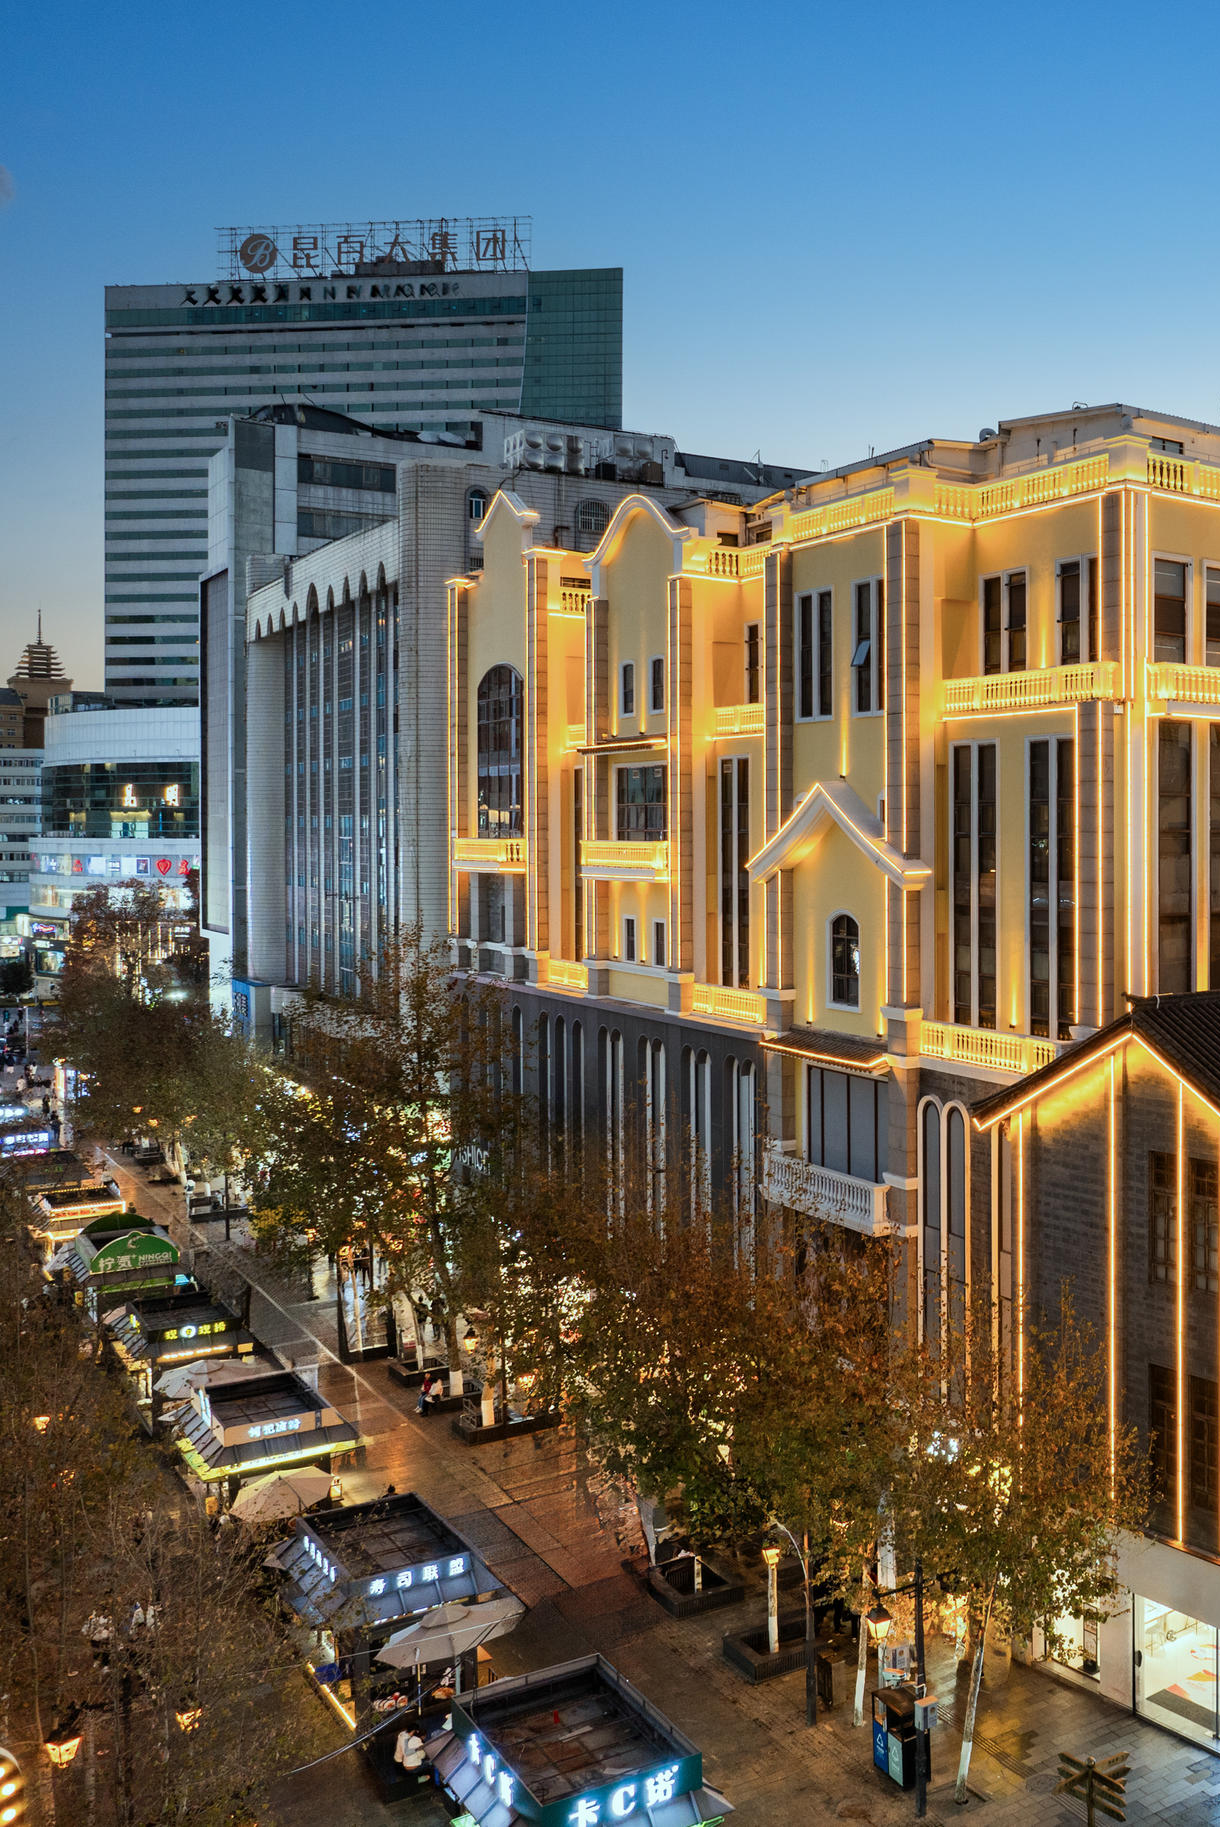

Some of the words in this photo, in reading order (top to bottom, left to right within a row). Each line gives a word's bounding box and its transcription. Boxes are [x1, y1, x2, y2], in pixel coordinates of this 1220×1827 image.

[292, 229, 506, 269] 昆百大集团
